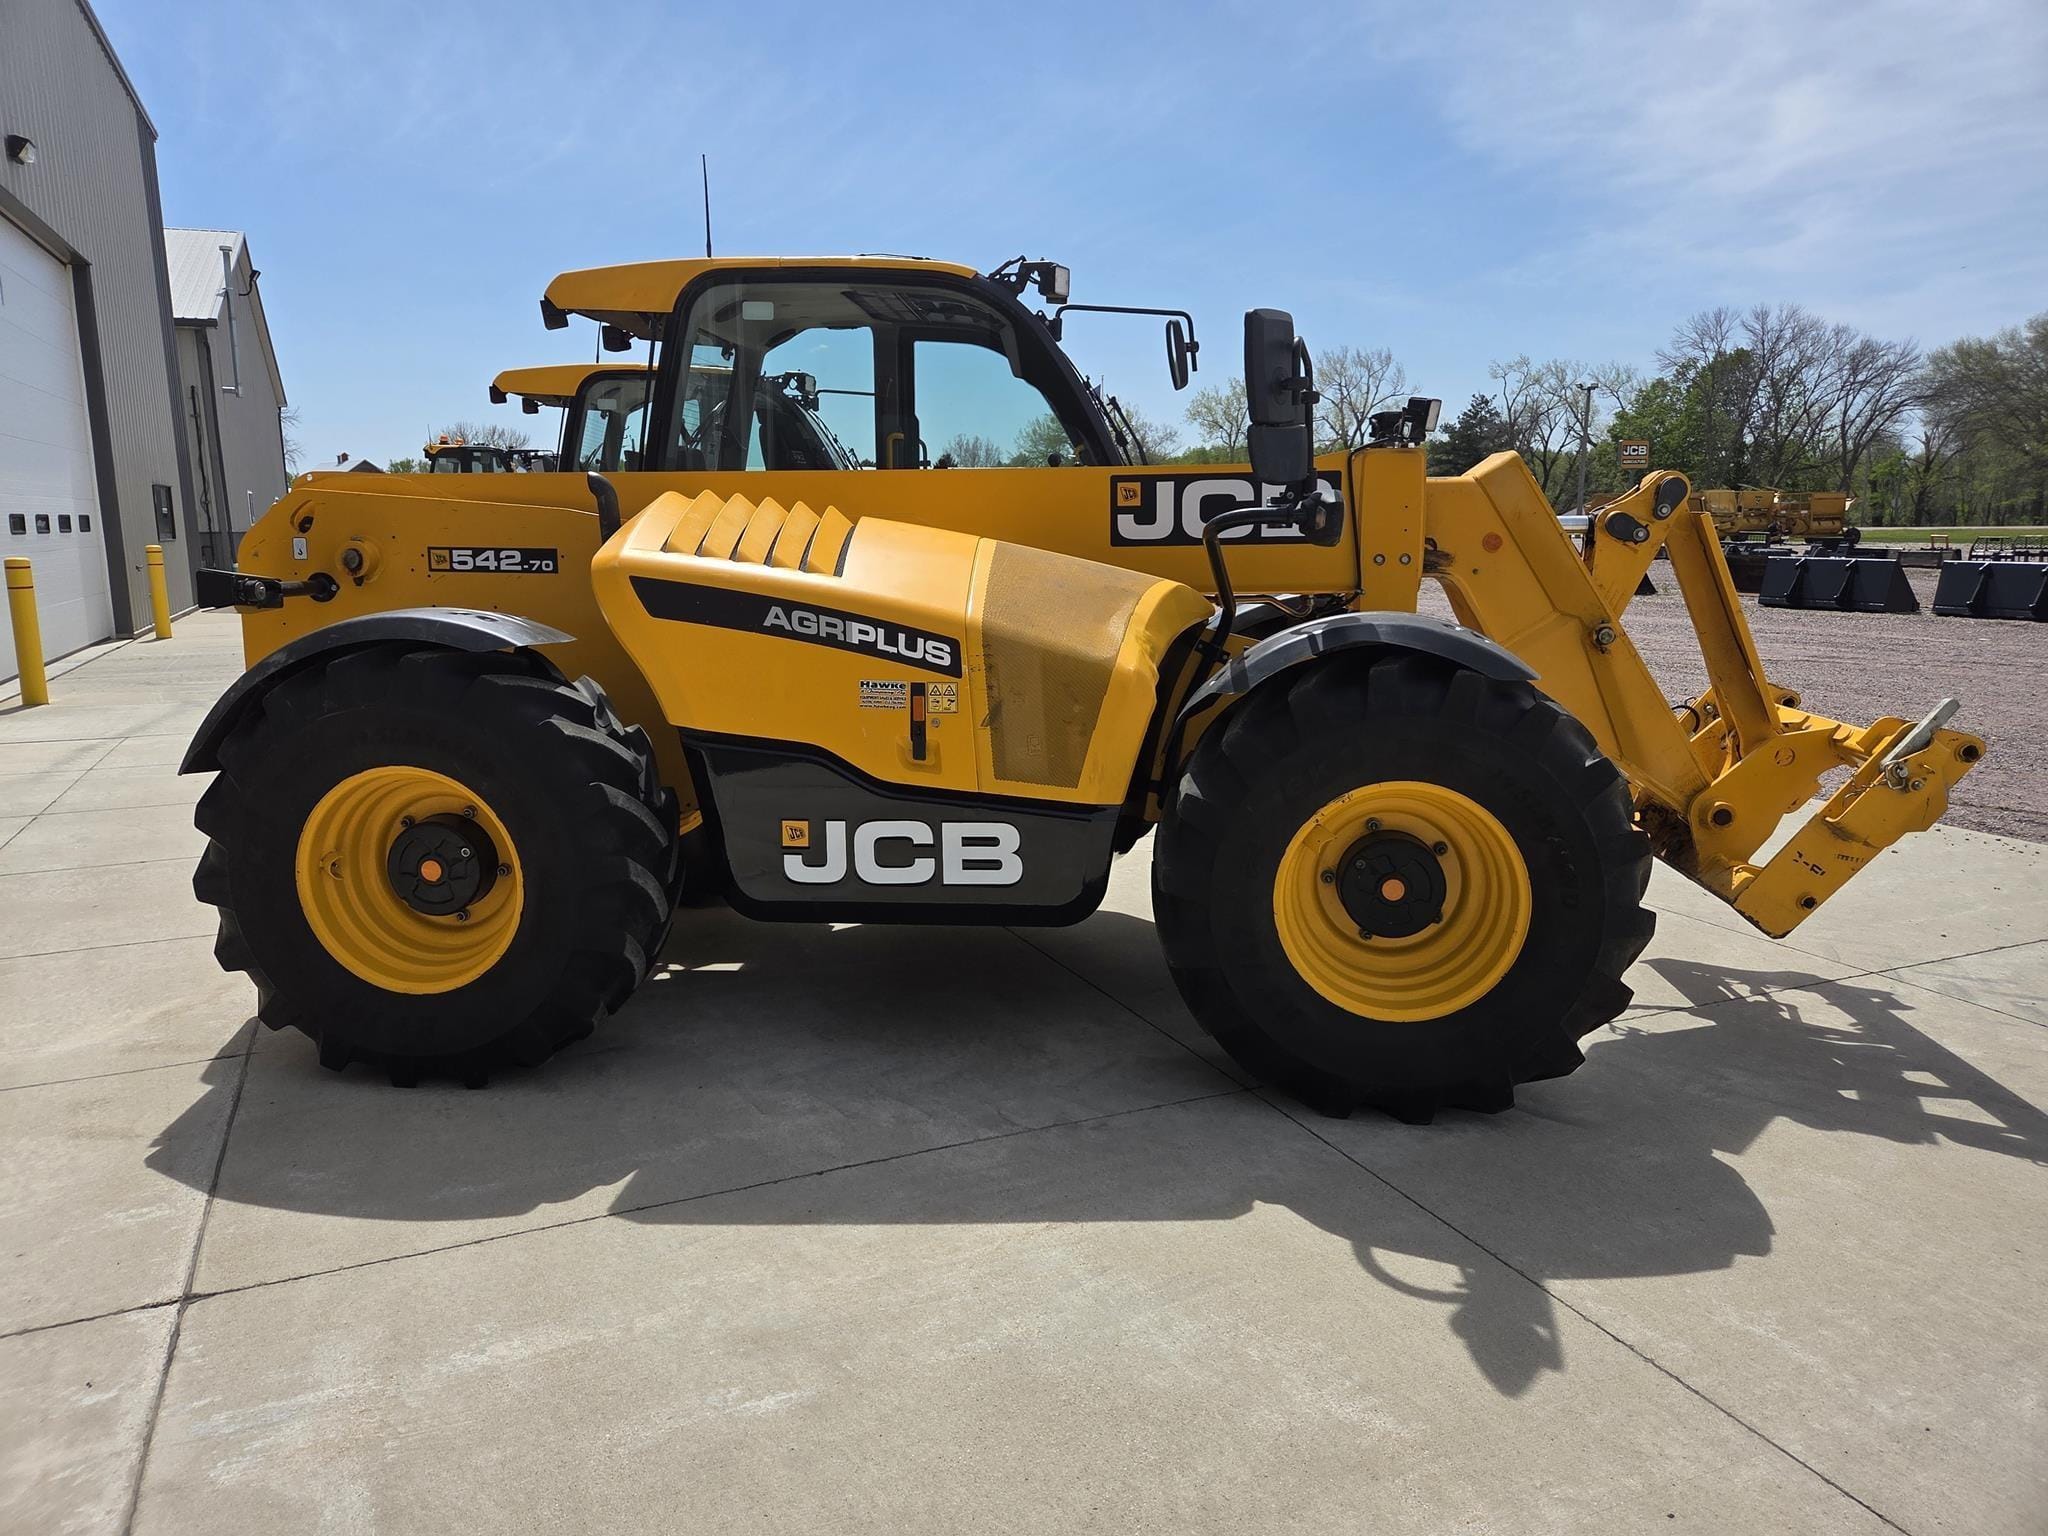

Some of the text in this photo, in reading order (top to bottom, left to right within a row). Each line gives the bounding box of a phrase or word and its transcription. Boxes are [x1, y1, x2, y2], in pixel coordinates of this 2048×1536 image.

[1623, 445, 1647, 455] JCB
[1117, 479, 1333, 540] JC
[763, 606, 951, 666] AGRIPLUS
[783, 820, 1023, 885] JCB
